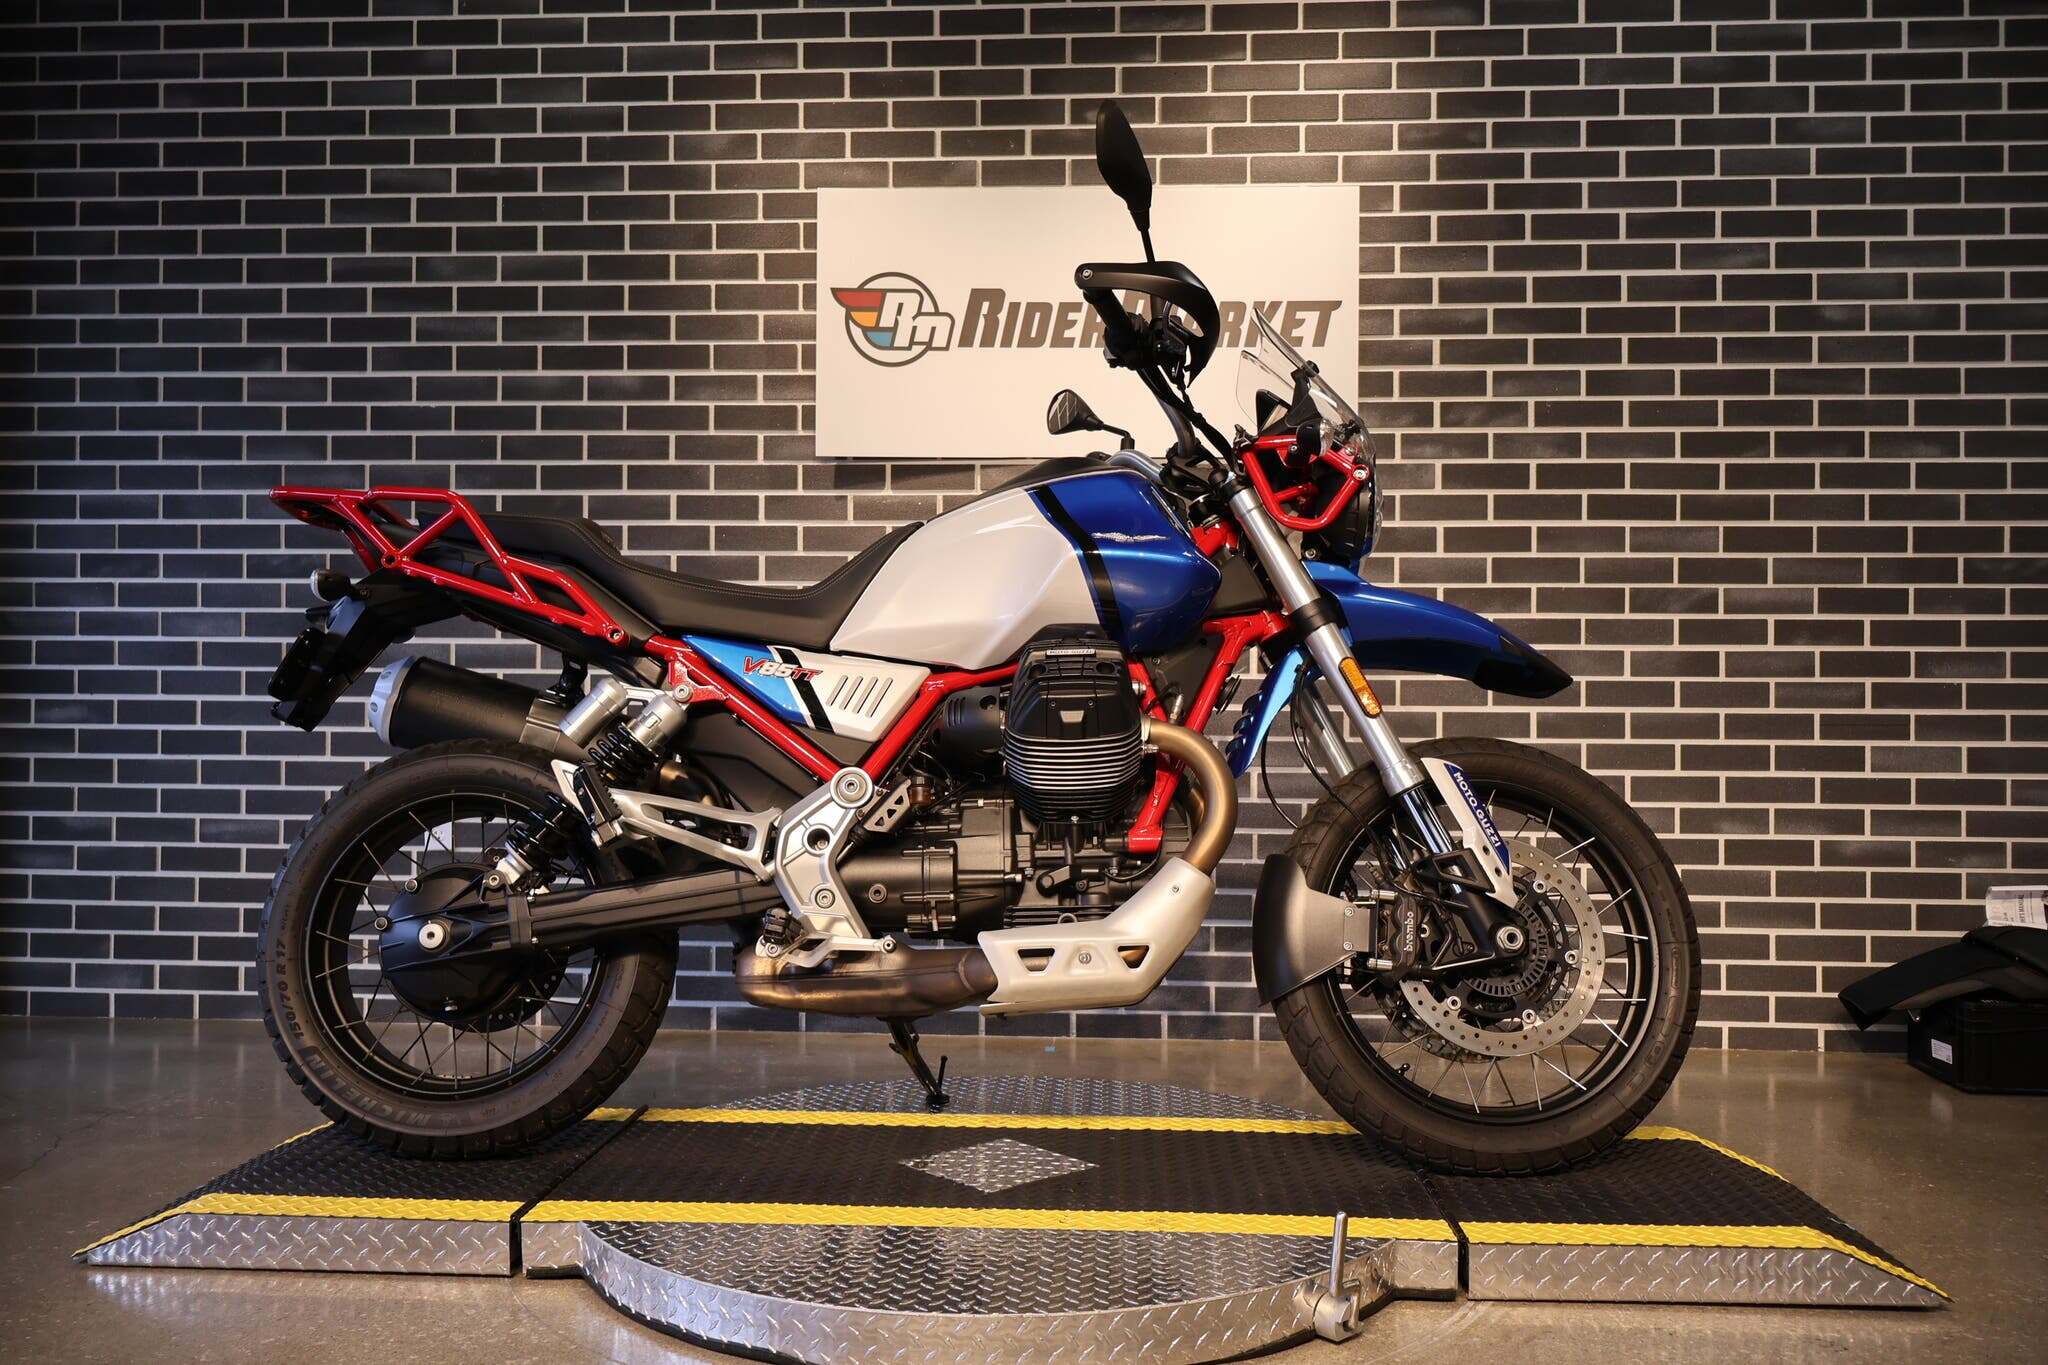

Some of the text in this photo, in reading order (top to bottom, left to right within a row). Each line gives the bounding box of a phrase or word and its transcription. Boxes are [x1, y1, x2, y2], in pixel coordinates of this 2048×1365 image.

[1119, 287, 1342, 348] RKET
[1453, 771, 1502, 847] MOTO GUZZI
[1403, 911, 1414, 952] brembo
